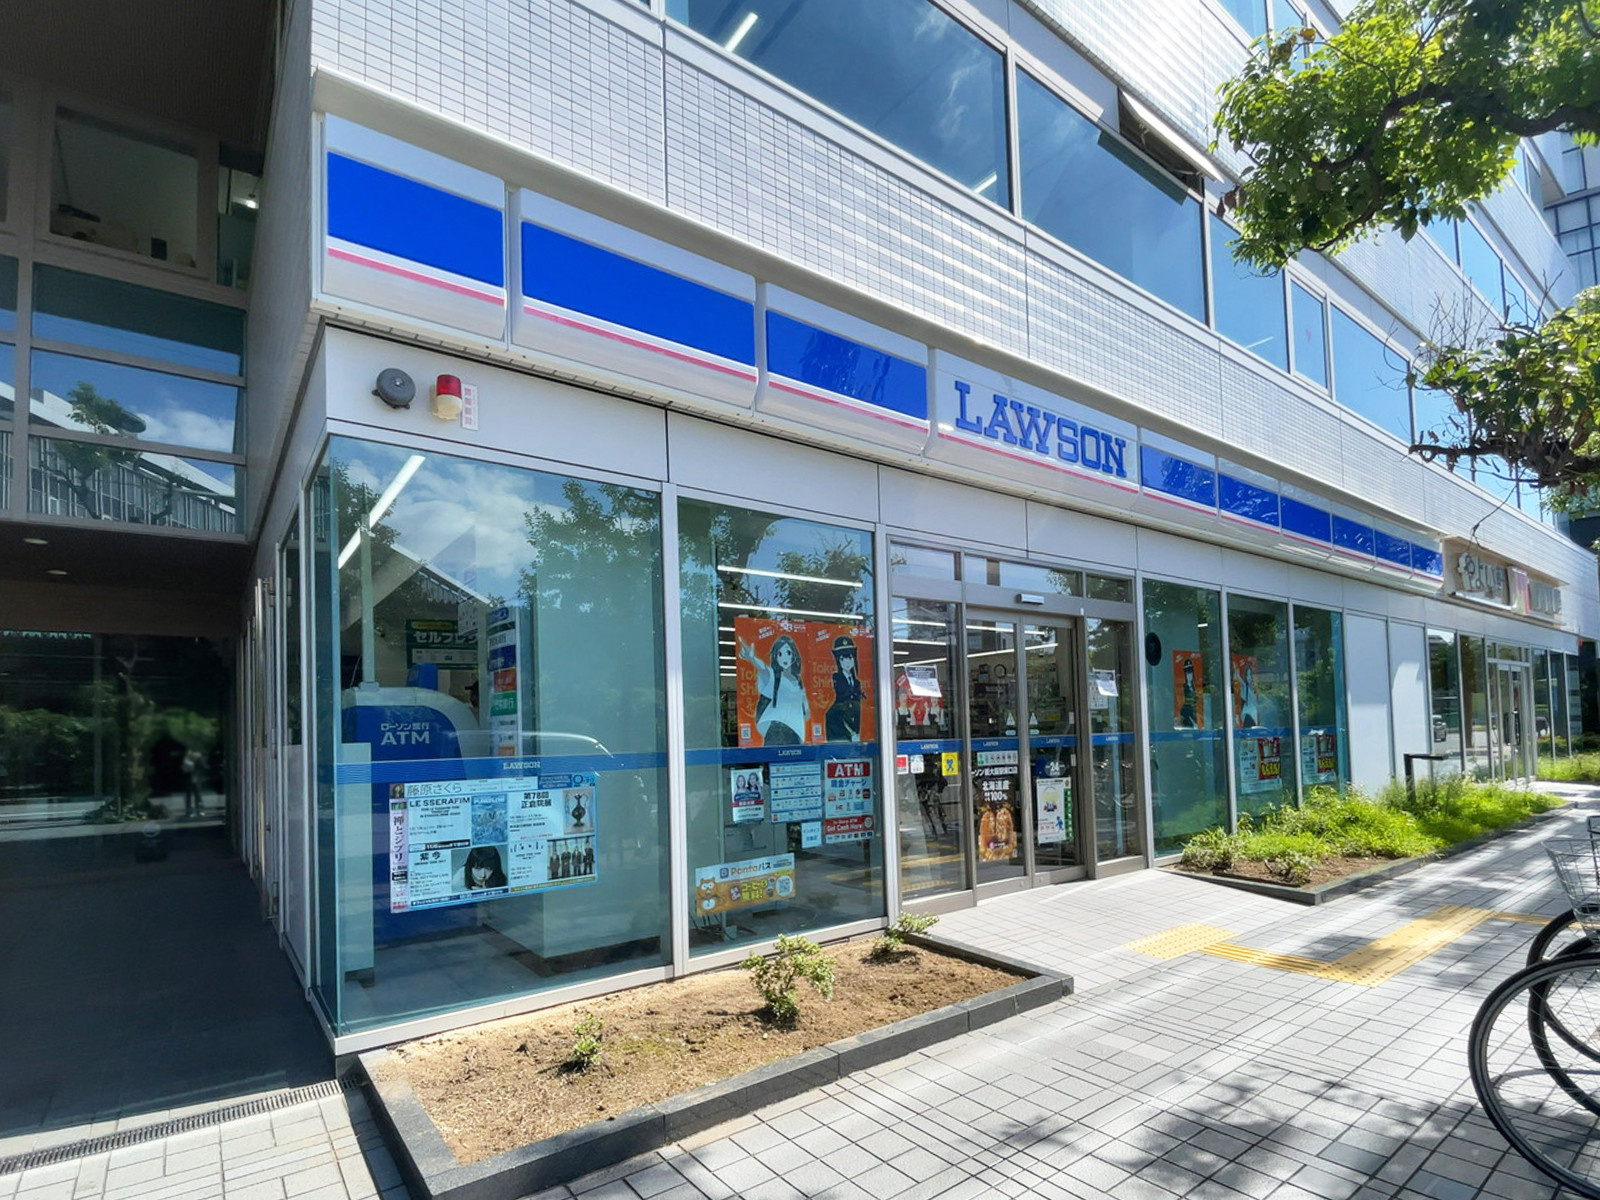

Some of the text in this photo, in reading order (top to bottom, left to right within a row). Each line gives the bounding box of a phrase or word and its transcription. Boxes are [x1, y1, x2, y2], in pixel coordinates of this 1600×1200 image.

[955, 380, 1127, 478] LAWSON
[380, 730, 431, 746] ATM
[502, 760, 541, 770] LAWSON
[834, 764, 864, 777] ATM
[406, 783, 463, 797] 藤原さくら
[409, 799, 423, 808] LE
[424, 796, 471, 806] SSERAFIM
